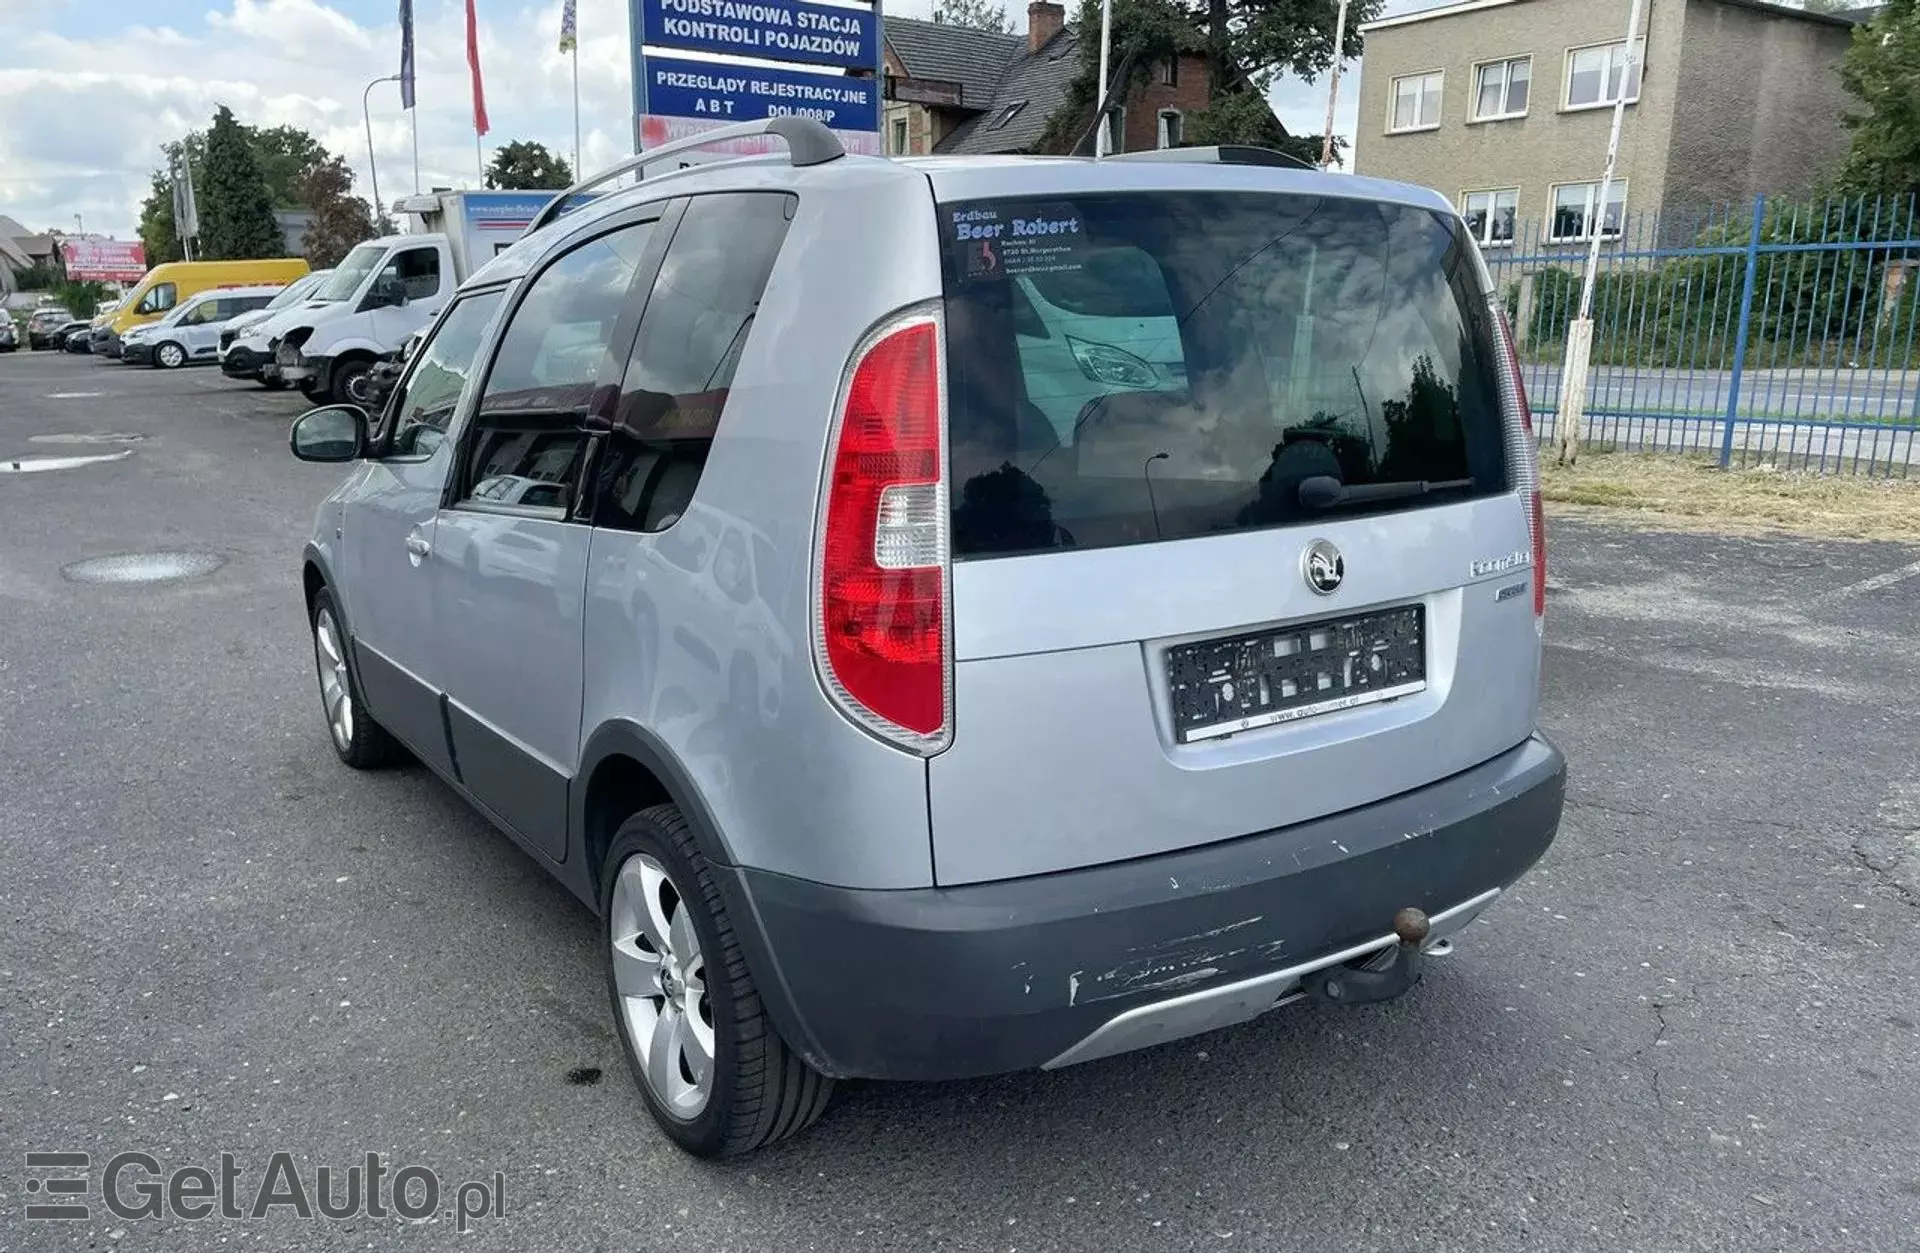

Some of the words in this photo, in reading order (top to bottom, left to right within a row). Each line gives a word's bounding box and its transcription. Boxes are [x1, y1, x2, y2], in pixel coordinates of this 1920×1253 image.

[661, 0, 793, 26] PODSTAWOWA
[797, 12, 861, 35] STACJA
[664, 18, 760, 45] KONTROLI
[765, 31, 860, 57] POJAZDÓW
[656, 71, 747, 95] PRZEGLĄDY
[751, 81, 867, 104] REJESTRACYJNE
[695, 98, 706, 112] A
[710, 99, 720, 113] B
[724, 100, 735, 114] T
[952, 210, 997, 222] Erdbau
[956, 223, 1004, 241] Beer
[1012, 216, 1080, 236] Robert
